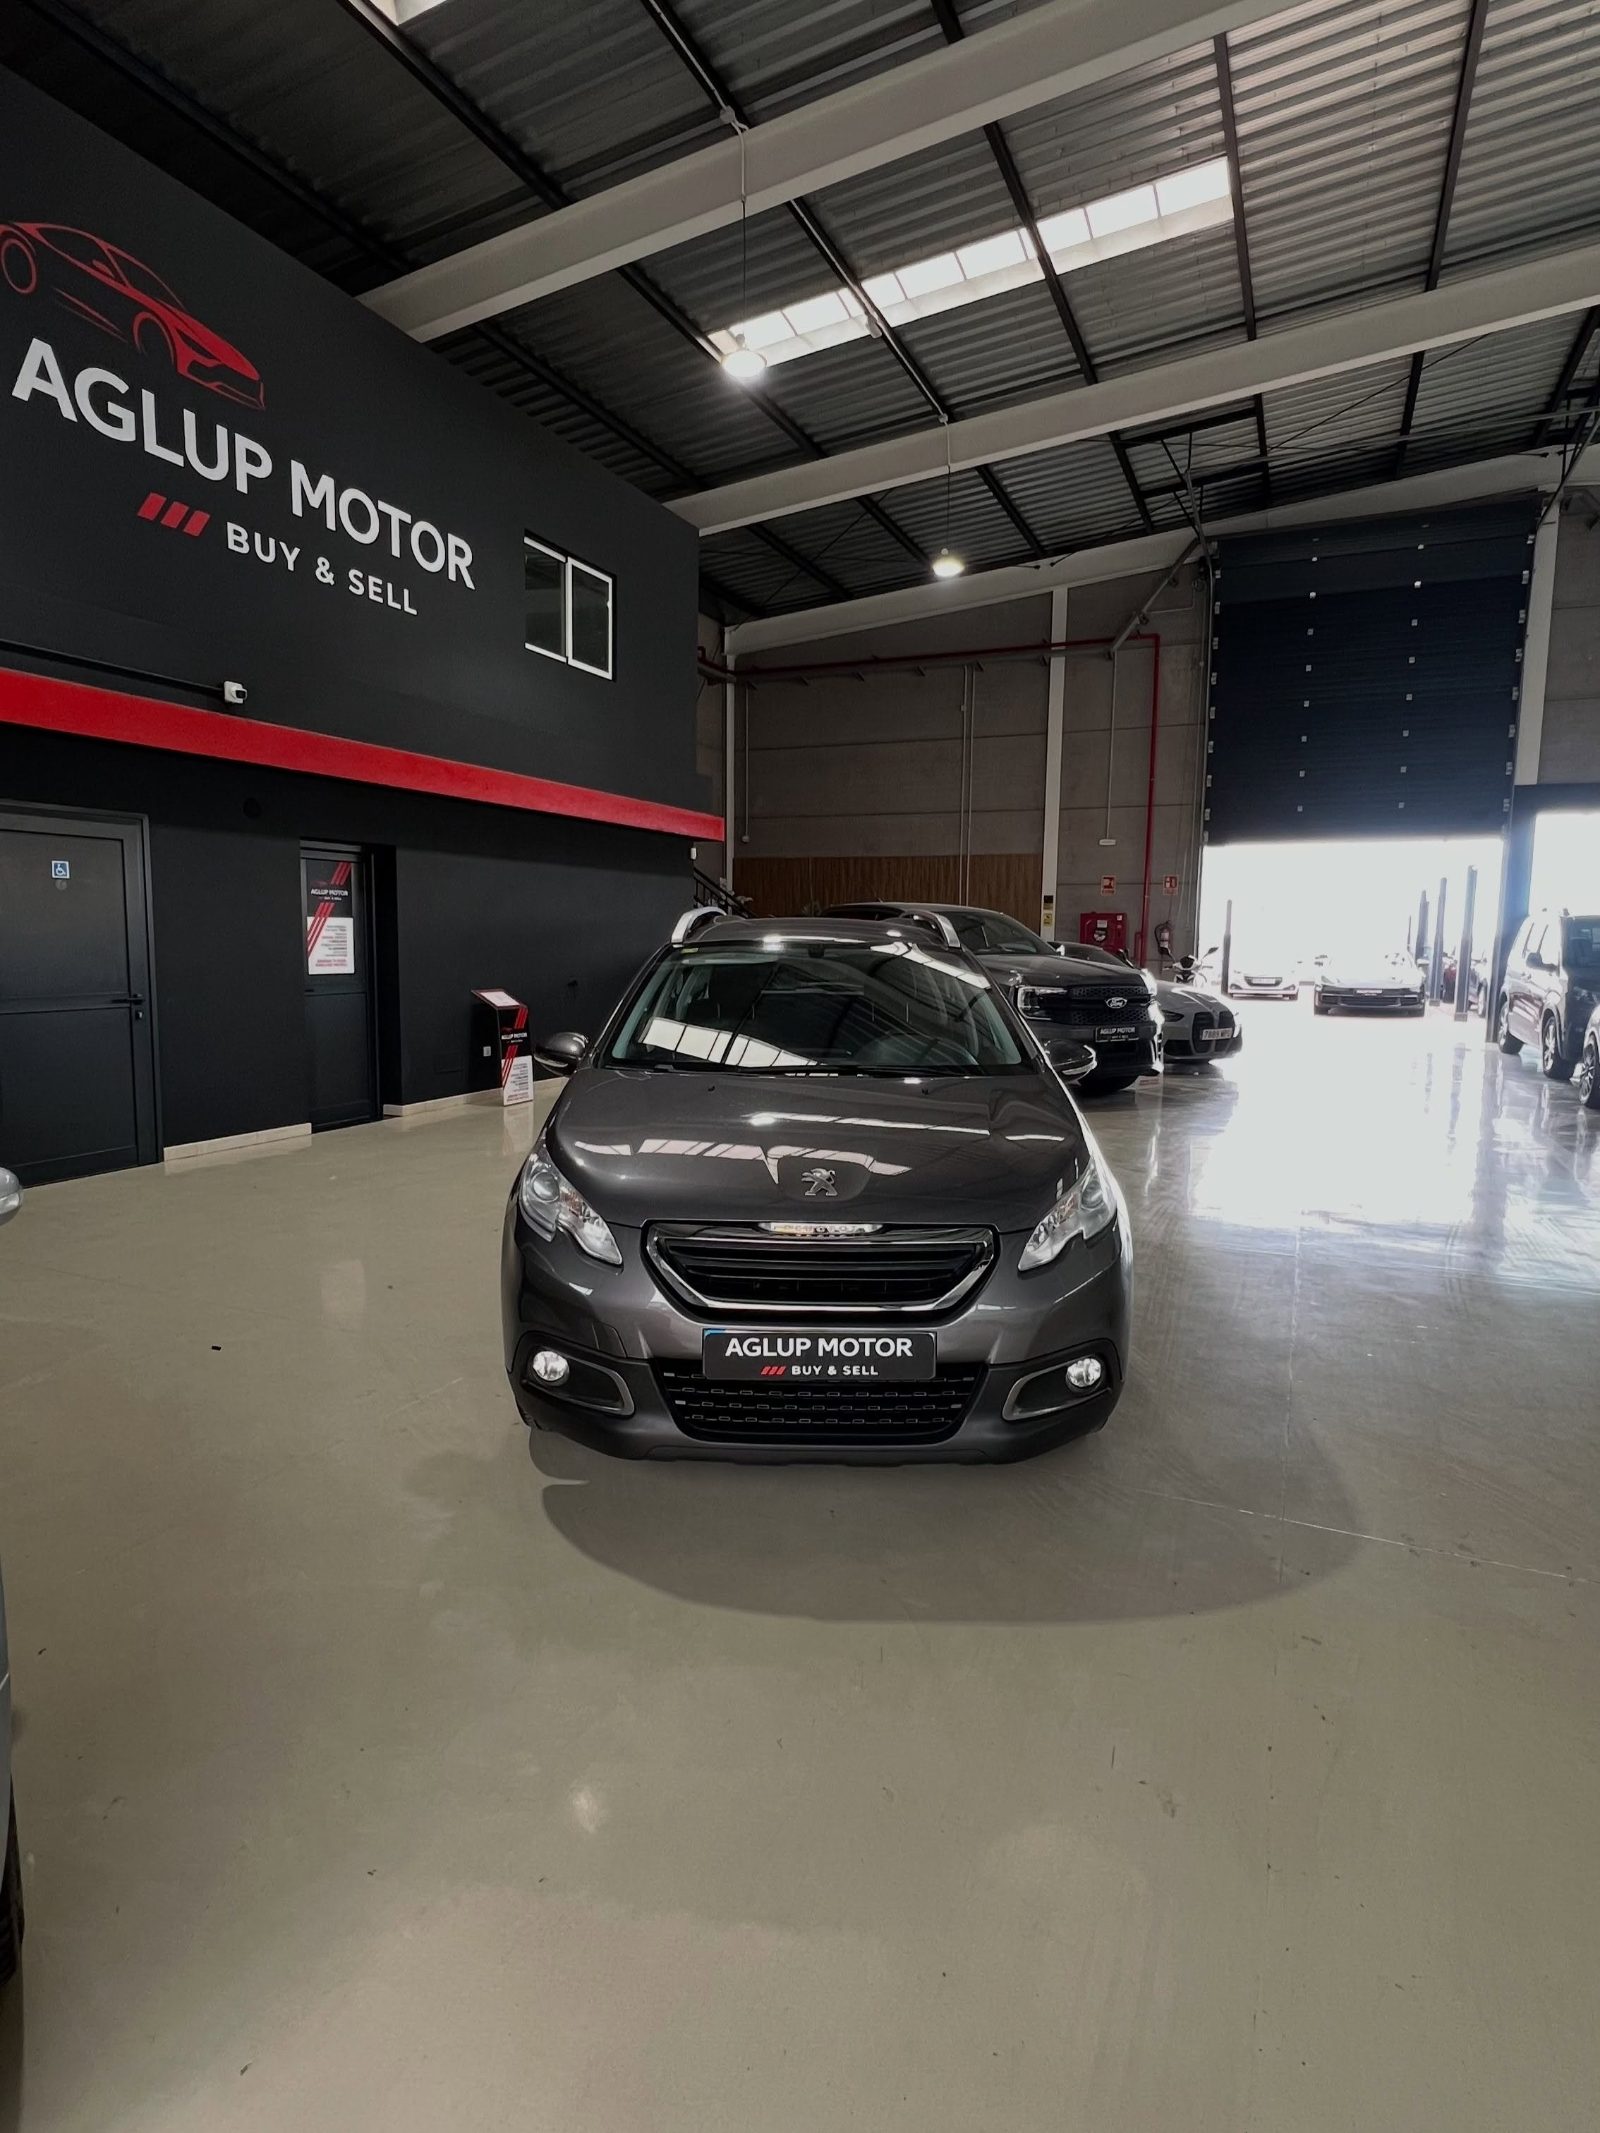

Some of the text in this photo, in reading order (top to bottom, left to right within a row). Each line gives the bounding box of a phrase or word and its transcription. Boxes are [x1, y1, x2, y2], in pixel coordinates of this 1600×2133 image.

[12, 338, 475, 590] AGLUP MOTOR
[226, 521, 418, 616] BUY & SELL
[725, 1337, 914, 1357] AGLUP MOTOR
[791, 1365, 879, 1376] BUY & SELL
